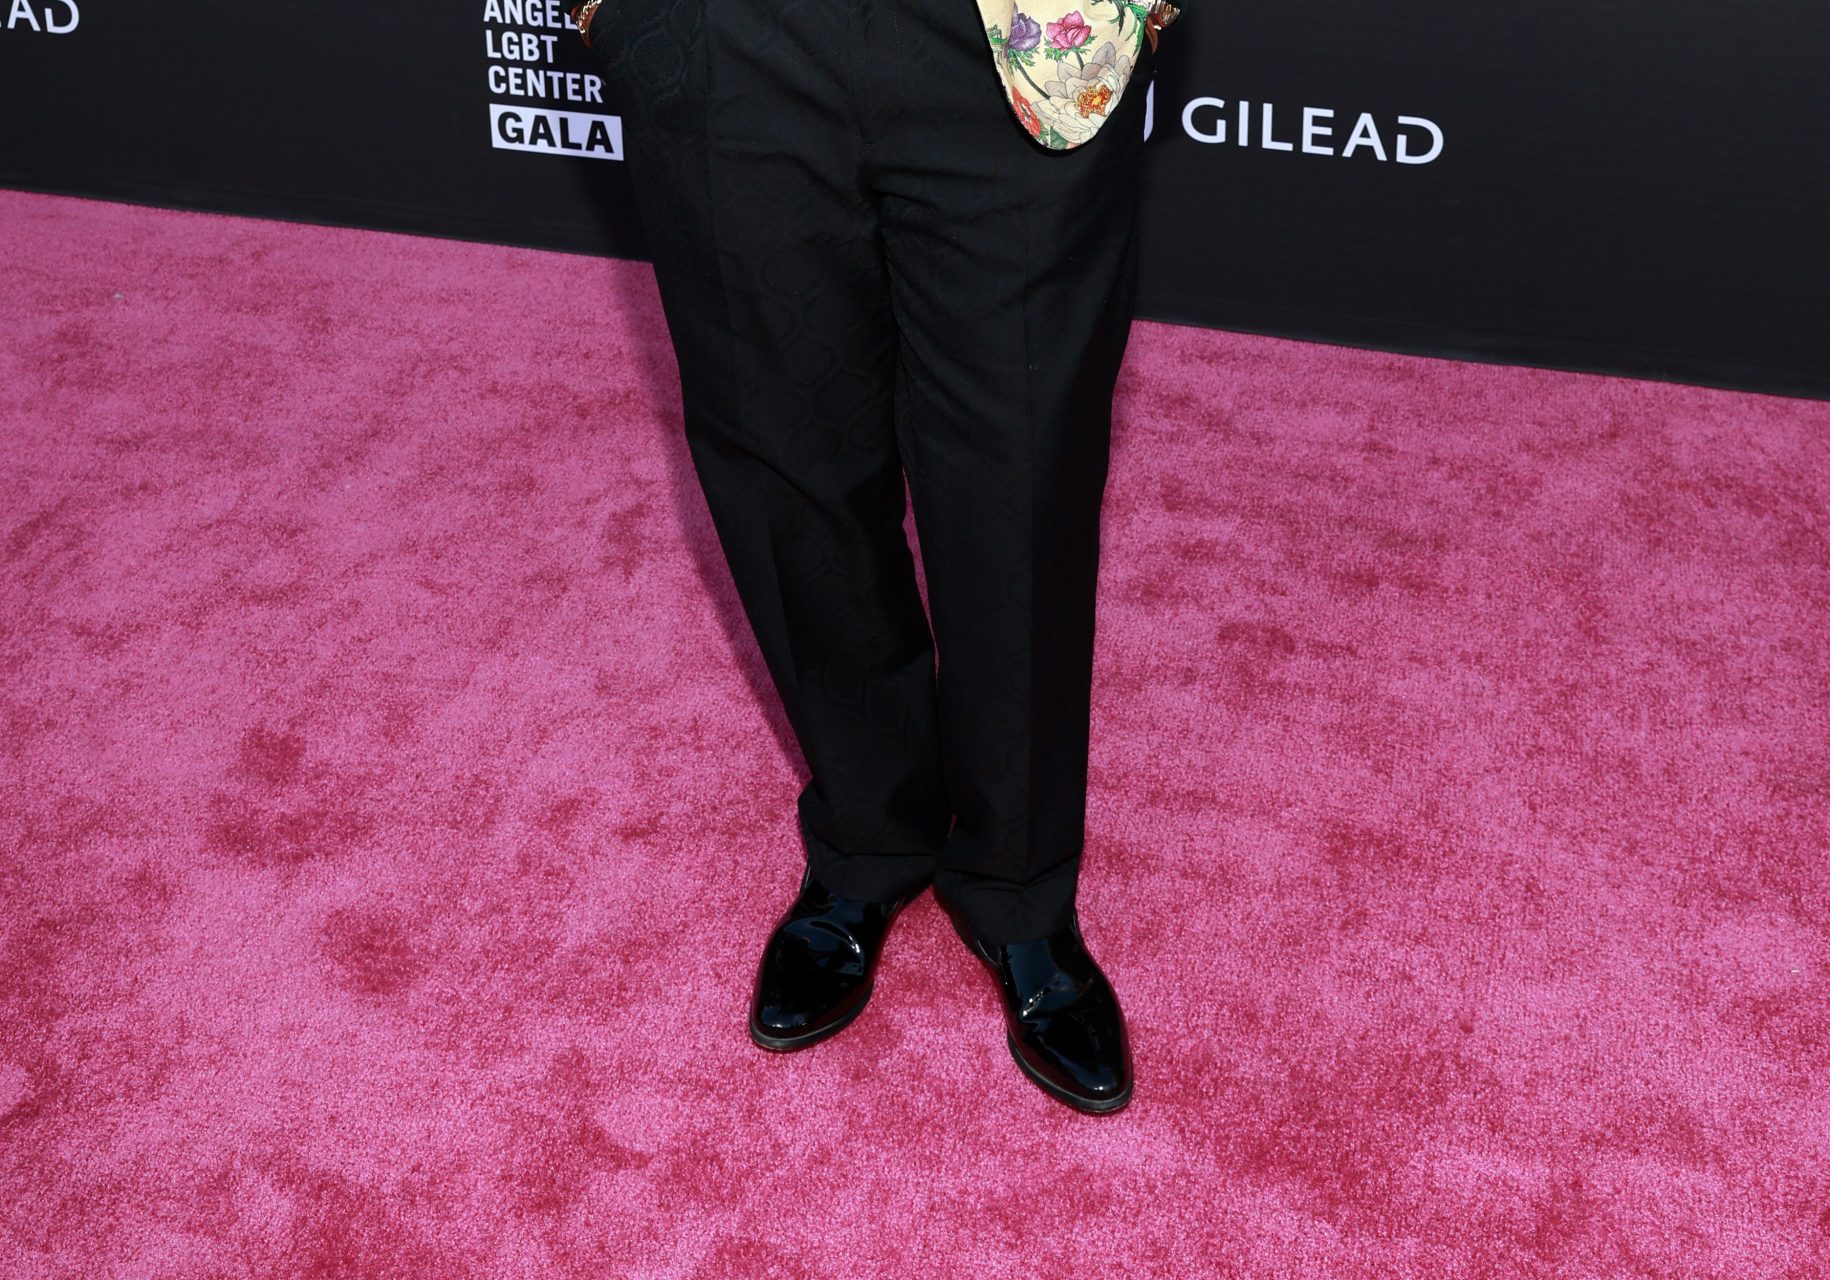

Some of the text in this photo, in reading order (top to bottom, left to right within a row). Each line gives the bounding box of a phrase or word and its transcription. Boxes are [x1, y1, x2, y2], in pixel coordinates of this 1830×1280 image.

[485, 29, 559, 64] LGBT
[497, 111, 615, 154] GALA
[1181, 96, 1444, 165] GILEAD
